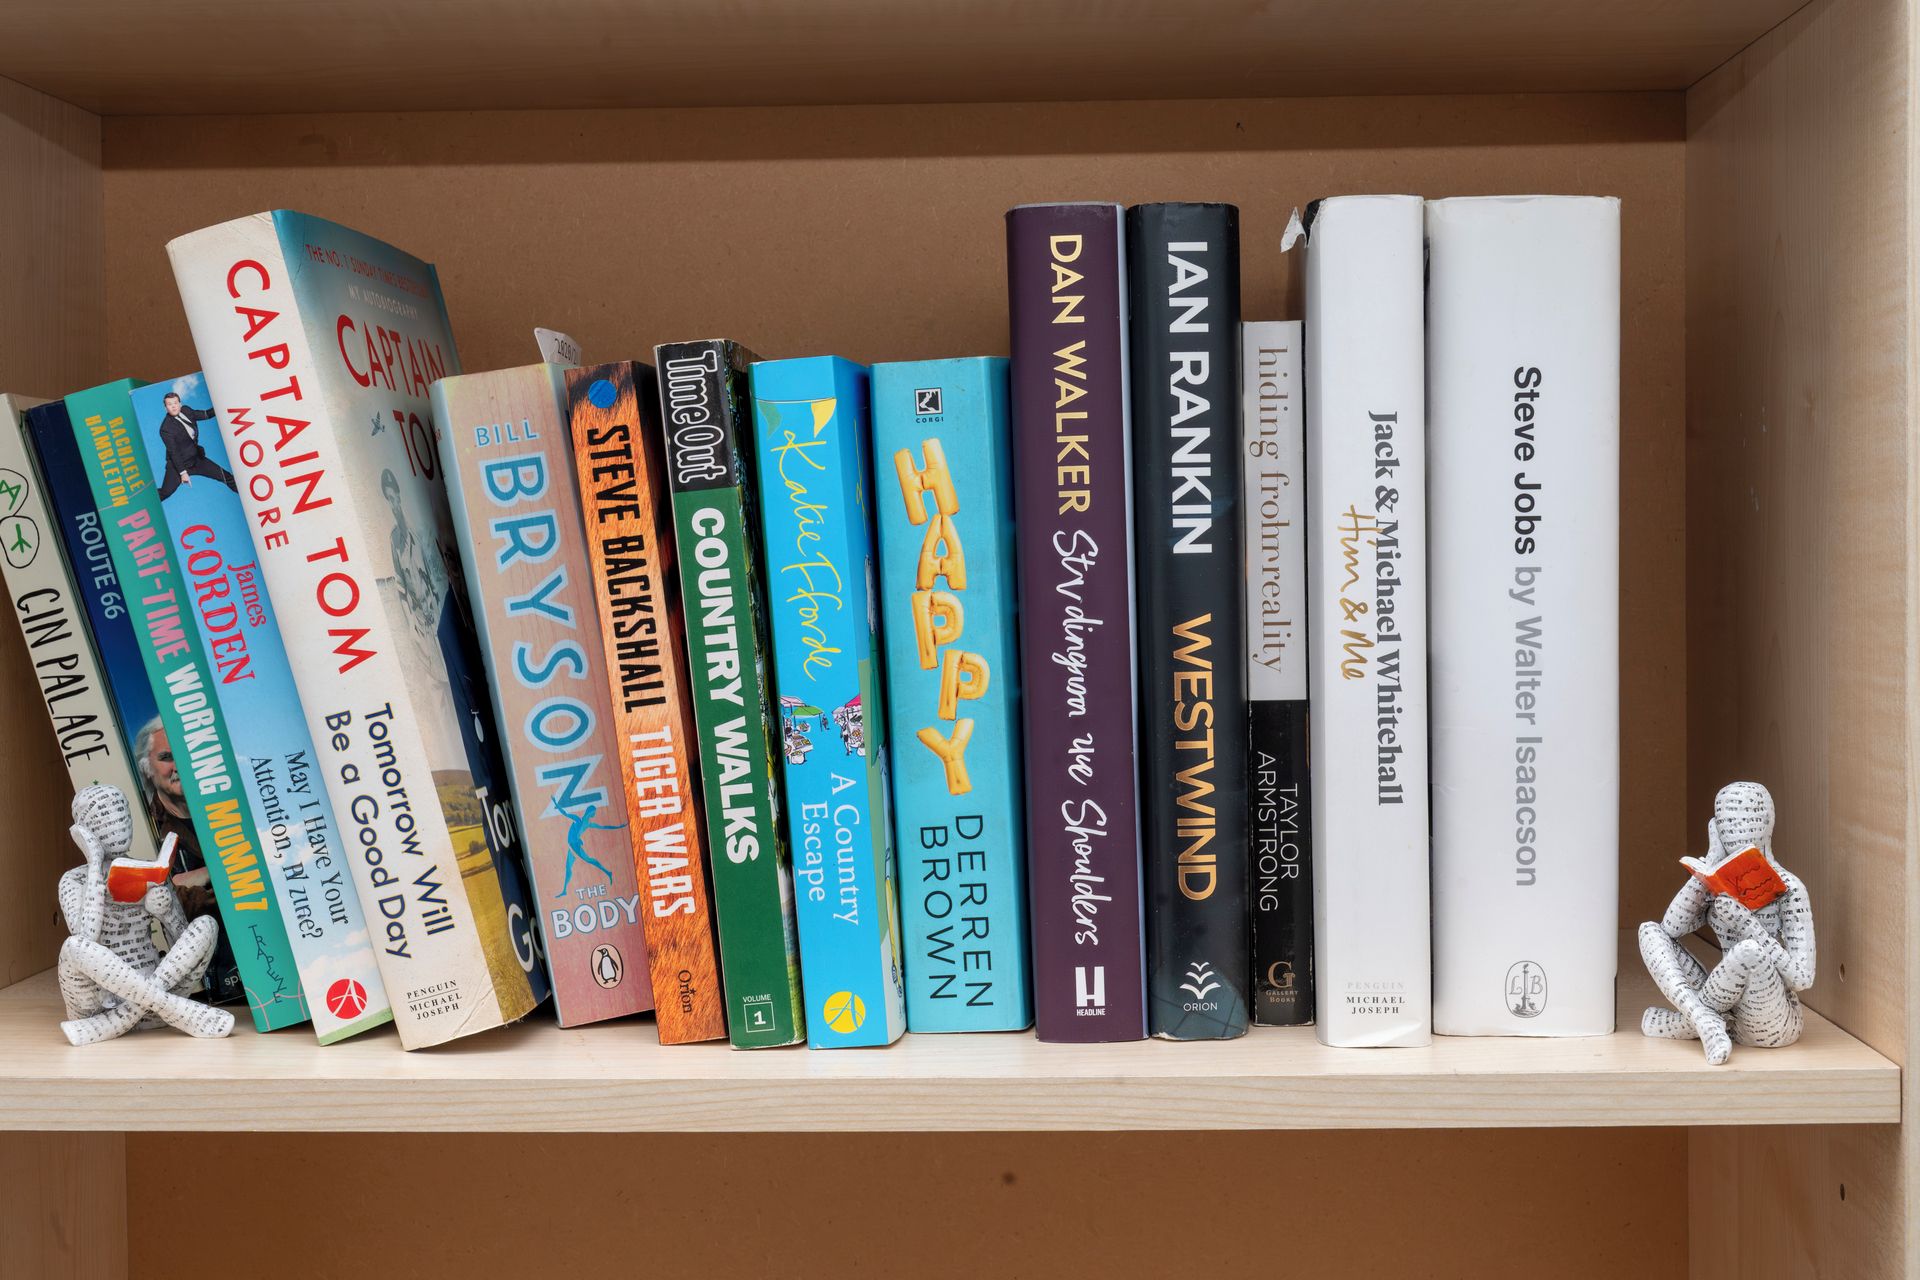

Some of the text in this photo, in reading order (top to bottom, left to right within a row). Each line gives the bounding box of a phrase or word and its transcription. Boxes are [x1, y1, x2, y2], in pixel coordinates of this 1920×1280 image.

[305, 244, 325, 264] THE
[1050, 234, 1086, 324] DAN
[392, 409, 443, 482] TO
[475, 418, 540, 448] BILL
[915, 416, 944, 424] CORGI
[1052, 340, 1092, 516] WALKER
[1249, 345, 1290, 460] hiding
[85, 414, 129, 507] HAMBLETON
[226, 258, 378, 675] CAPTAIN TOM
[227, 407, 289, 552] MOORE
[75, 510, 126, 620] ROUTE 66
[180, 523, 256, 684] CORDEN
[228, 560, 267, 628] James
[1167, 241, 1217, 901] IAN RANKIN WESTWIND
[1339, 597, 1369, 622] &
[1368, 410, 1404, 806] Jack & Michael Whitehall
[16, 587, 73, 649] GIN
[117, 508, 190, 664] PART-TIME
[164, 662, 233, 795] WORKING
[480, 450, 607, 820] BRYSON
[893, 437, 991, 796] HAPPY
[1340, 629, 1375, 680] Me
[1508, 366, 1543, 887] Steve Jobs by Walter Isaacson
[36, 653, 110, 768] PALACE
[586, 424, 696, 919] STEVE BACKSHALL TIGER WARS
[691, 507, 760, 866] COUNTRY WALKS
[250, 757, 293, 859] Attention,
[285, 750, 349, 924] May I Have Your
[325, 709, 413, 960] Be a Good Day
[364, 702, 456, 937] Tomorrow Will
[798, 801, 829, 902] Escape
[830, 772, 860, 926] A Country
[1257, 751, 1279, 912] ARMSTRONG
[1278, 782, 1300, 880] TAYLOR
[550, 894, 640, 940] BODY
[575, 884, 608, 899] THE
[919, 825, 958, 1001] BROWN
[954, 814, 995, 1008] DERREN
[1060, 799, 1113, 946] Shoulders
[406, 979, 457, 1000] PENGUIN
[409, 992, 463, 1013] MICHAEL
[416, 1002, 460, 1020] JOSEPH
[677, 969, 697, 1014] Orion
[742, 993, 772, 1003] VOLUME
[753, 1010, 767, 1025] 1
[1076, 1008, 1106, 1016] HEADLINE
[1183, 1002, 1218, 1012] ORION
[1267, 961, 1296, 988] G
[1346, 996, 1406, 1004] MICHAEL
[1351, 1006, 1399, 1015] JOSEPH
